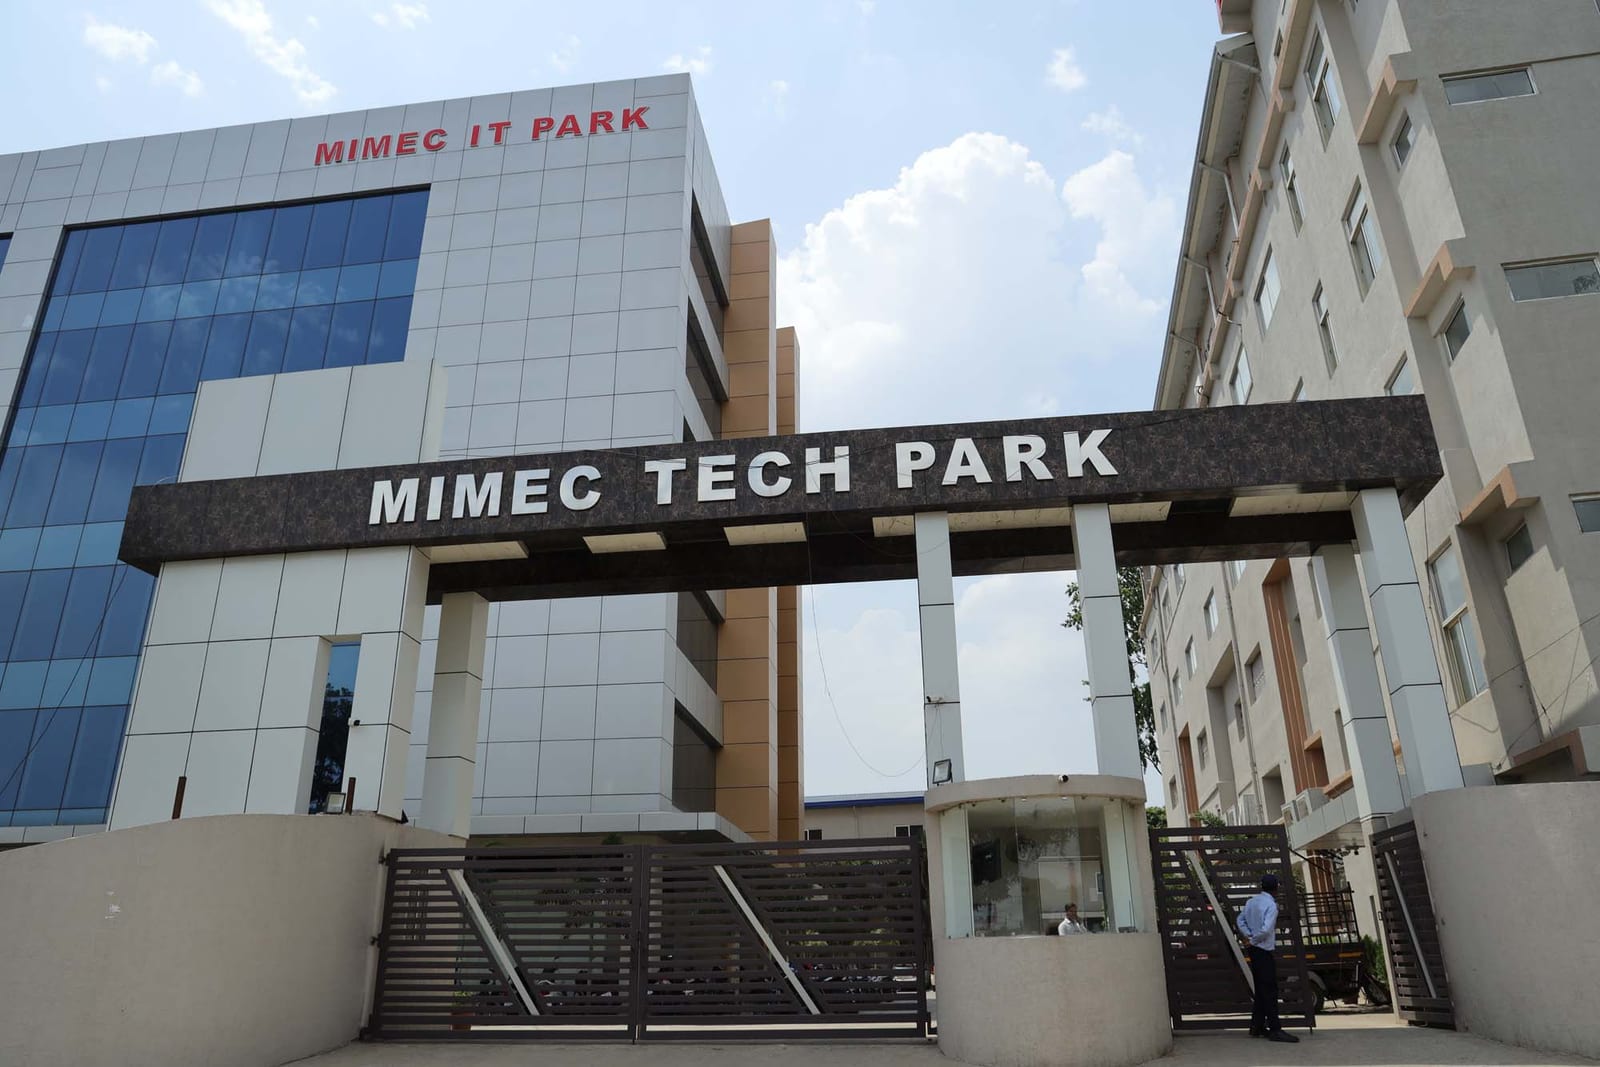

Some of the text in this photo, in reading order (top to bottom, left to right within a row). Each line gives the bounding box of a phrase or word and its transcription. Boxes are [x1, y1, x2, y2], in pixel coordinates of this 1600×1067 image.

[315, 106, 650, 165] MIMEC IT PARK
[368, 428, 1119, 525] MIMEC TECH PARK
